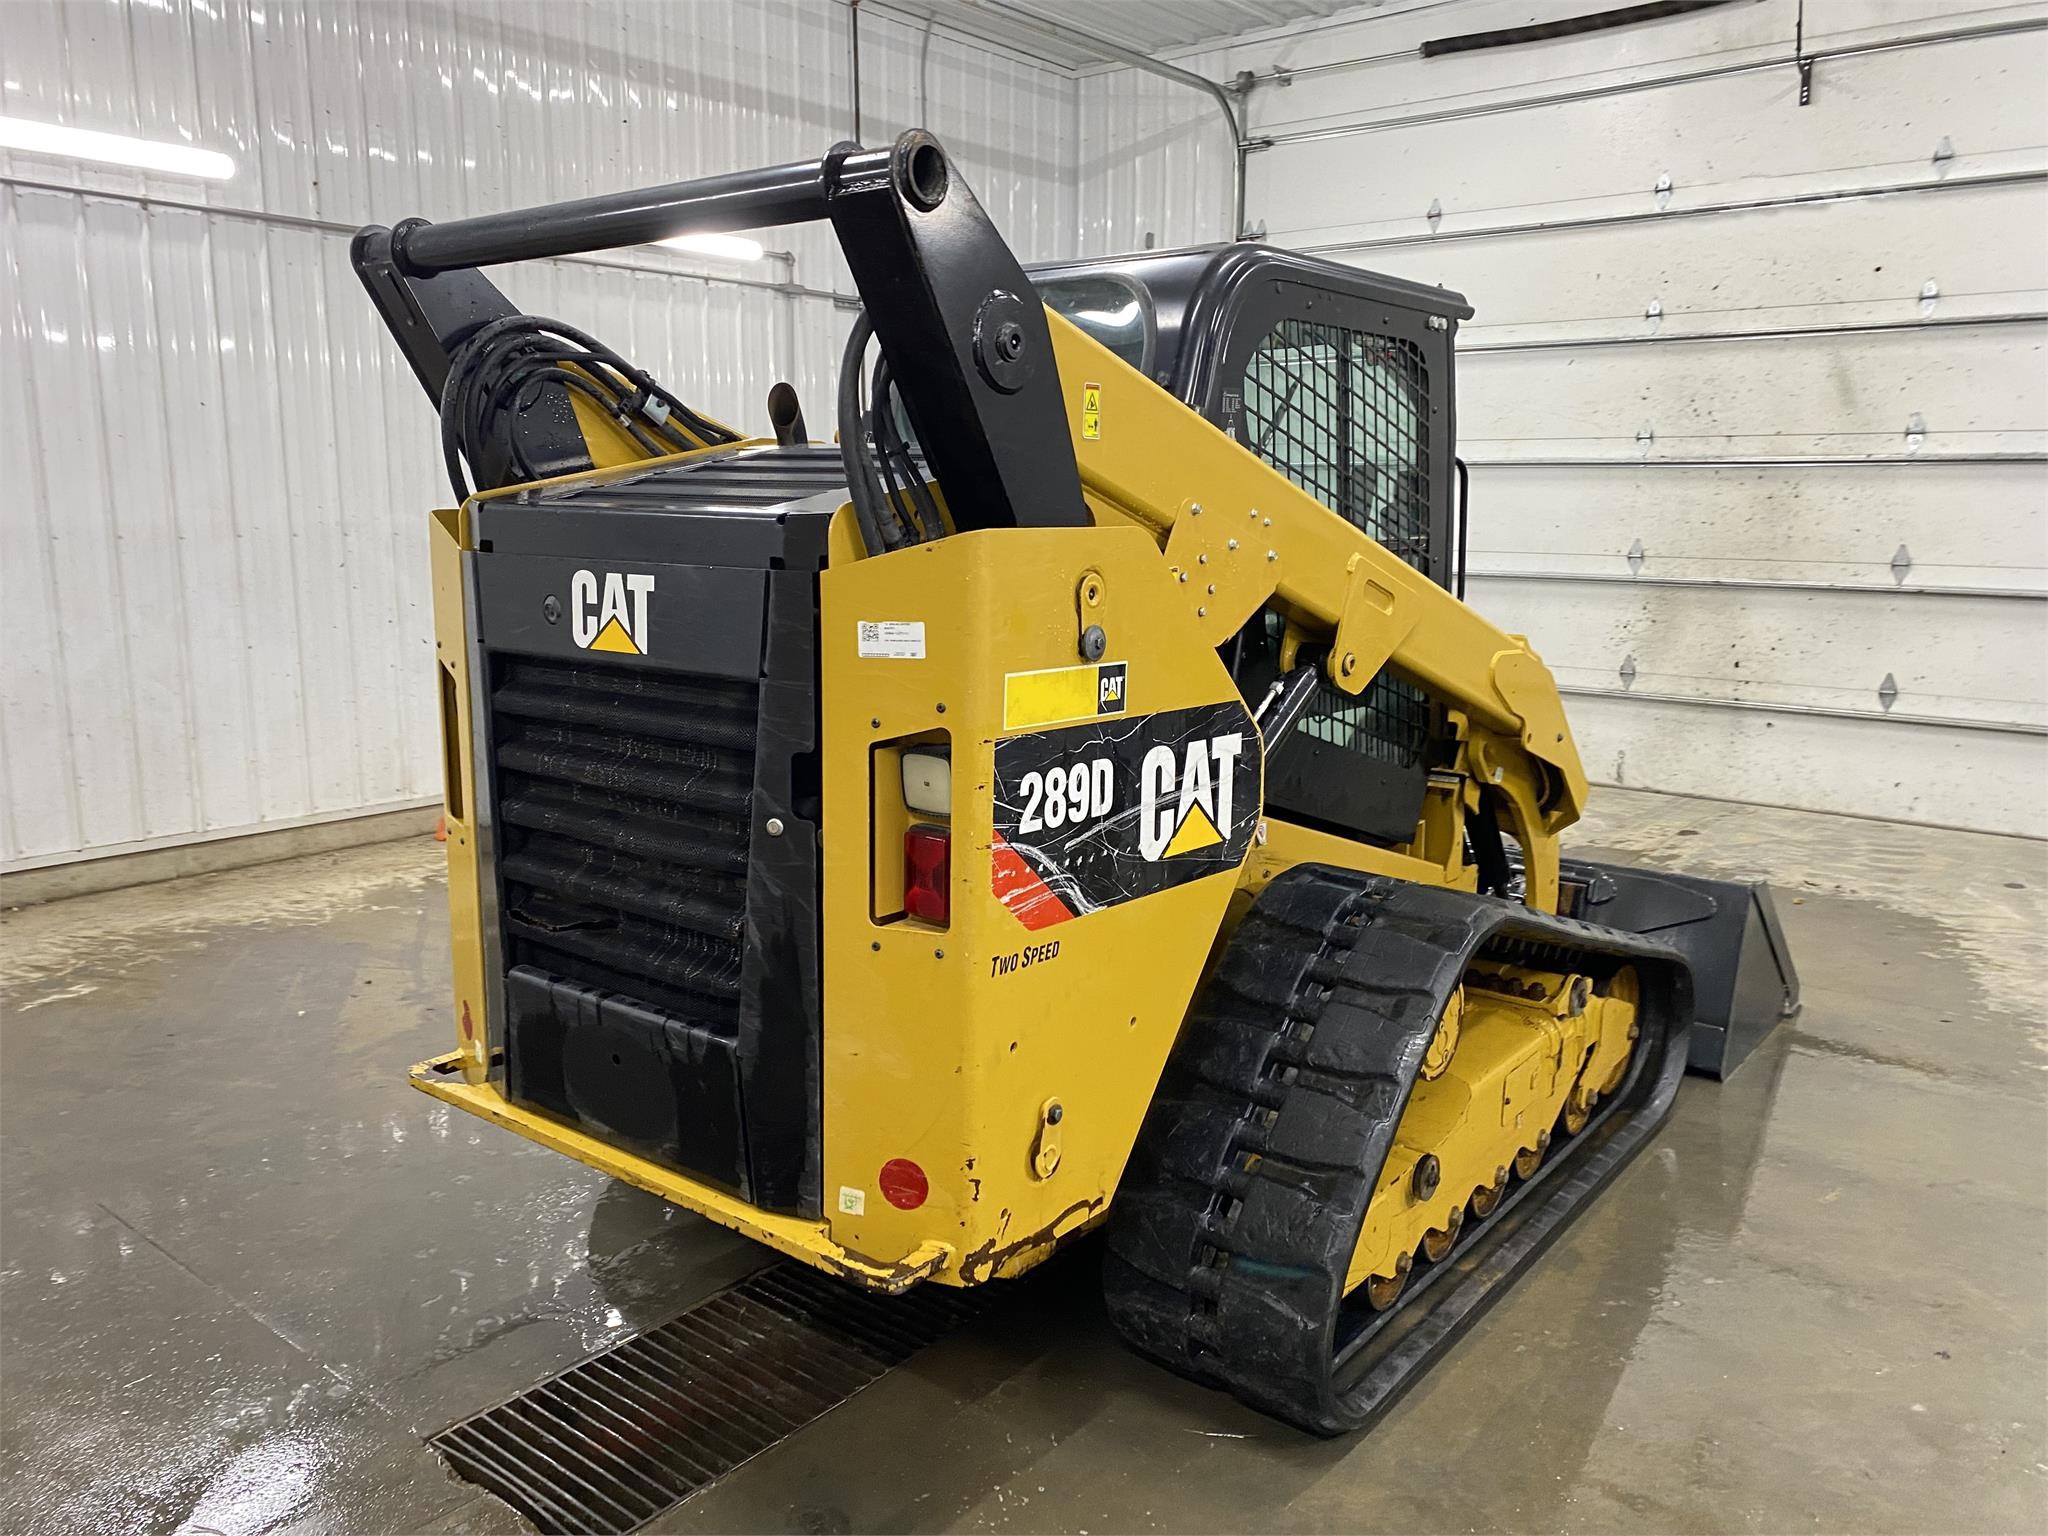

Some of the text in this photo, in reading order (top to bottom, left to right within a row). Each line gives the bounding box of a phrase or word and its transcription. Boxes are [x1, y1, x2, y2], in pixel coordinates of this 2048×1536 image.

[571, 569, 655, 655] CAT
[1100, 676, 1123, 702] CAT
[1018, 732, 1243, 862] 289D CAT
[991, 940, 1060, 978] TWO SPEED
